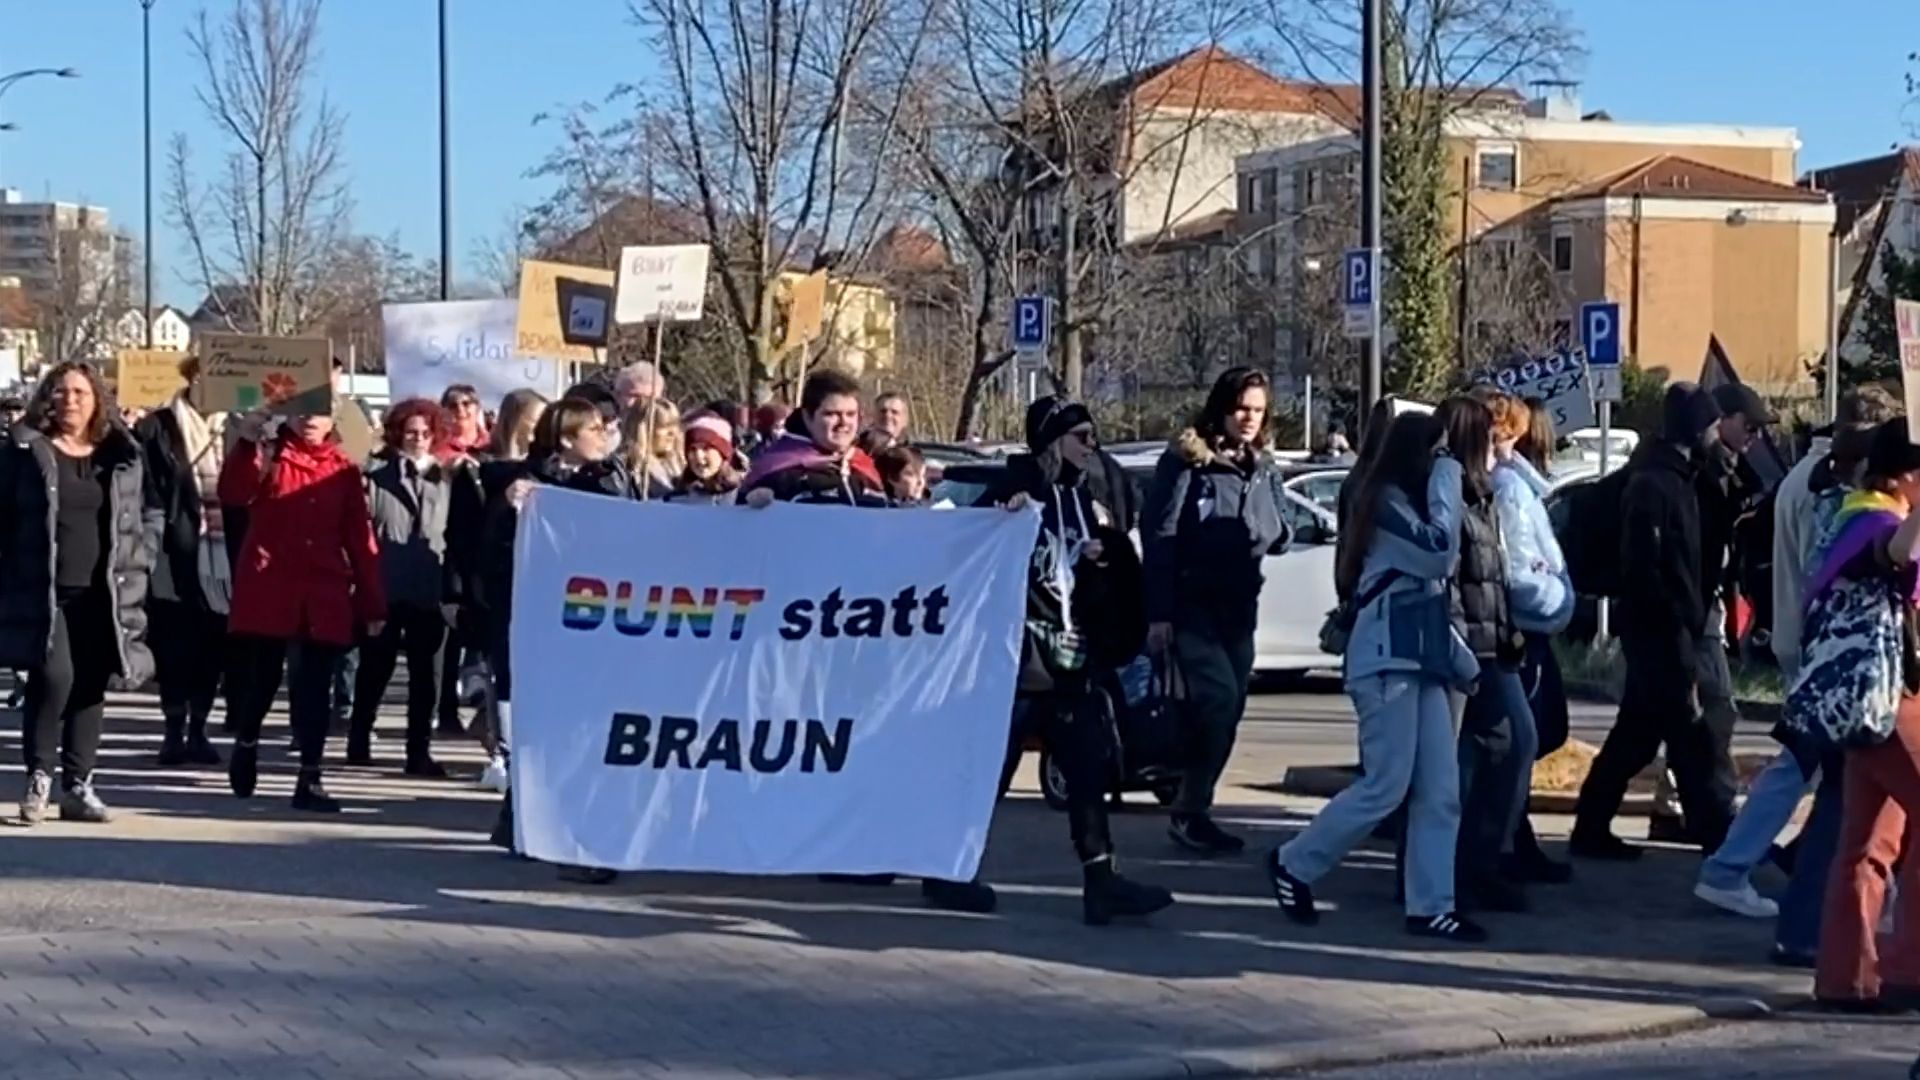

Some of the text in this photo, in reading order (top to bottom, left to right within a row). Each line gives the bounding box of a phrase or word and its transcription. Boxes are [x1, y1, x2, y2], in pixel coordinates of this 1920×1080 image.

[1350, 257, 1366, 299] P
[1020, 303, 1037, 338] P
[1589, 311, 1611, 358] P
[562, 576, 949, 641] BUNT statt
[604, 713, 853, 773] BRAUN
